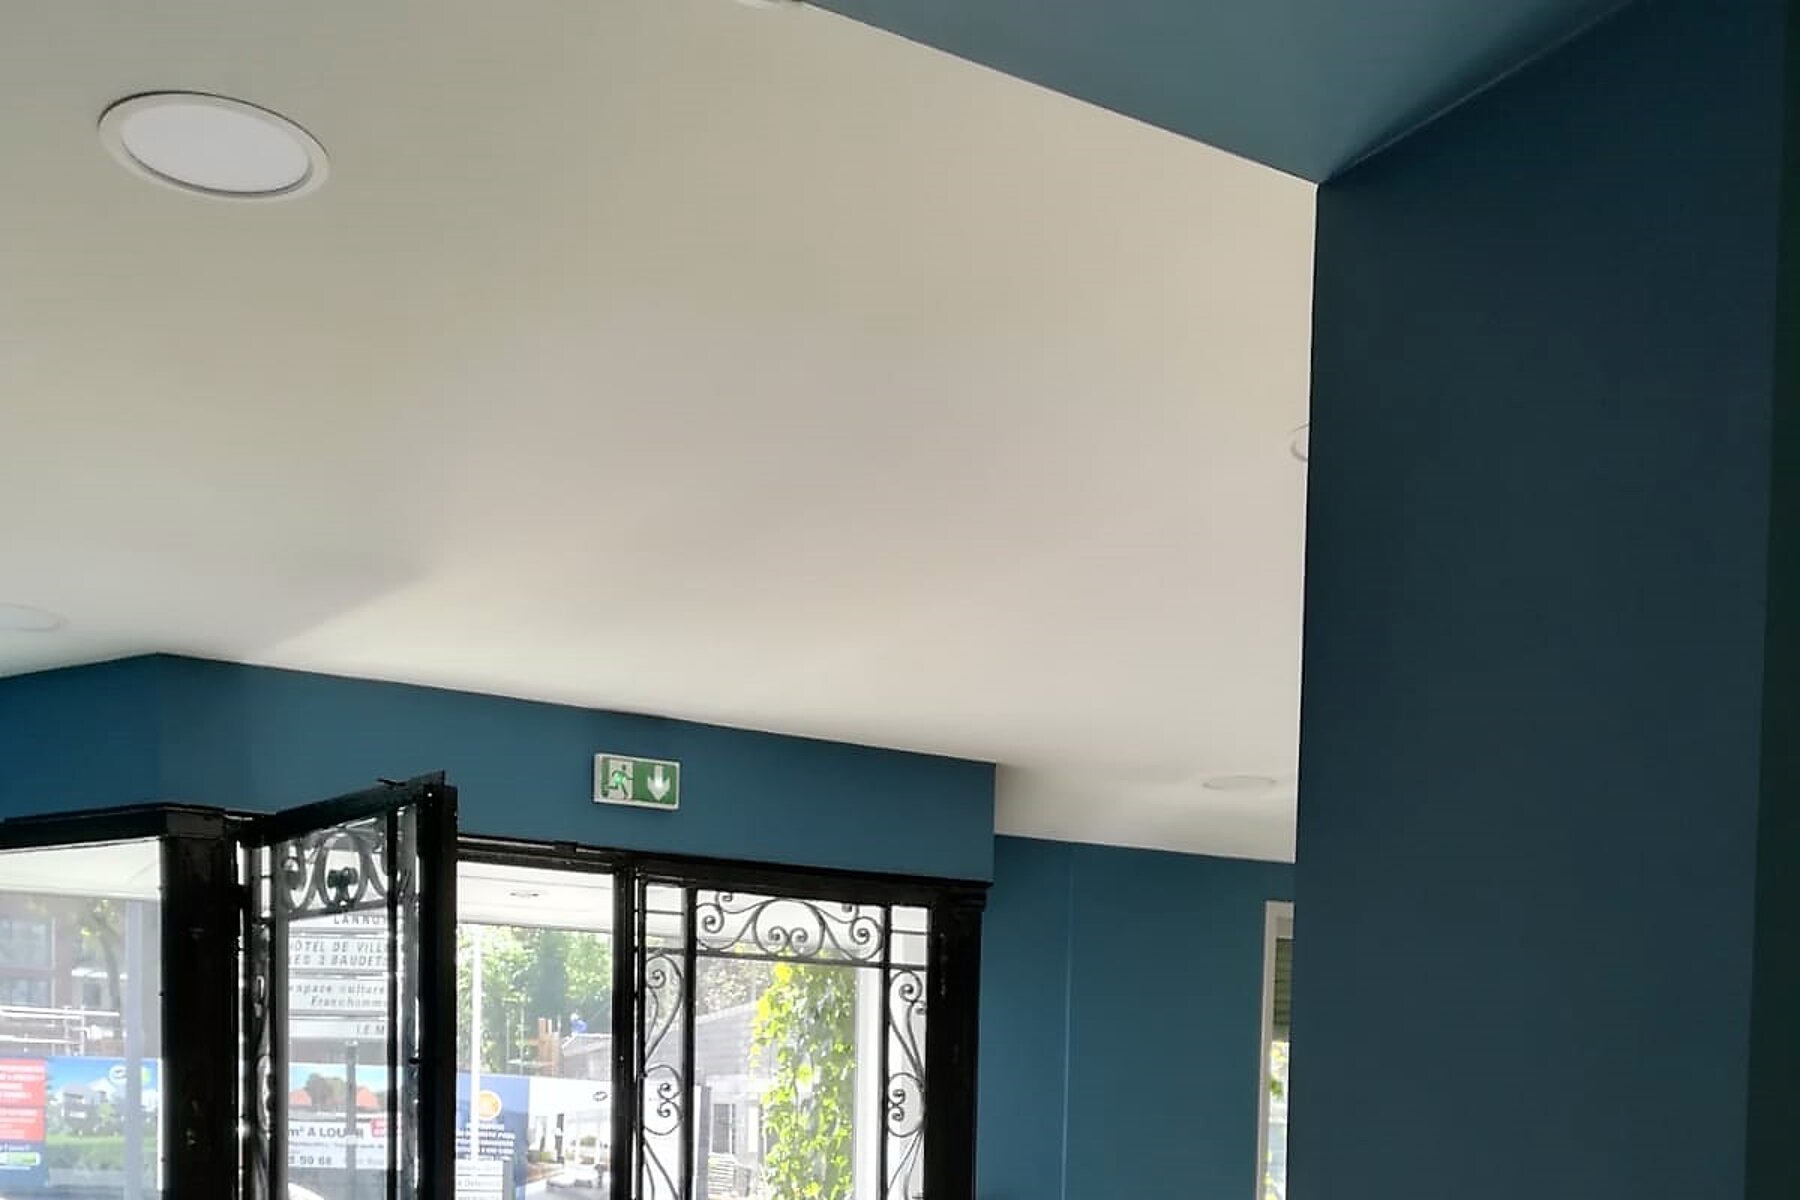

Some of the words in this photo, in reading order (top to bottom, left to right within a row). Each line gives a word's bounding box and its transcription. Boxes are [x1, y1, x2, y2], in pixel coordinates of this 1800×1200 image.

[332, 941, 348, 953] DE
[358, 941, 385, 953] VILL
[331, 954, 385, 967] BAUDET
